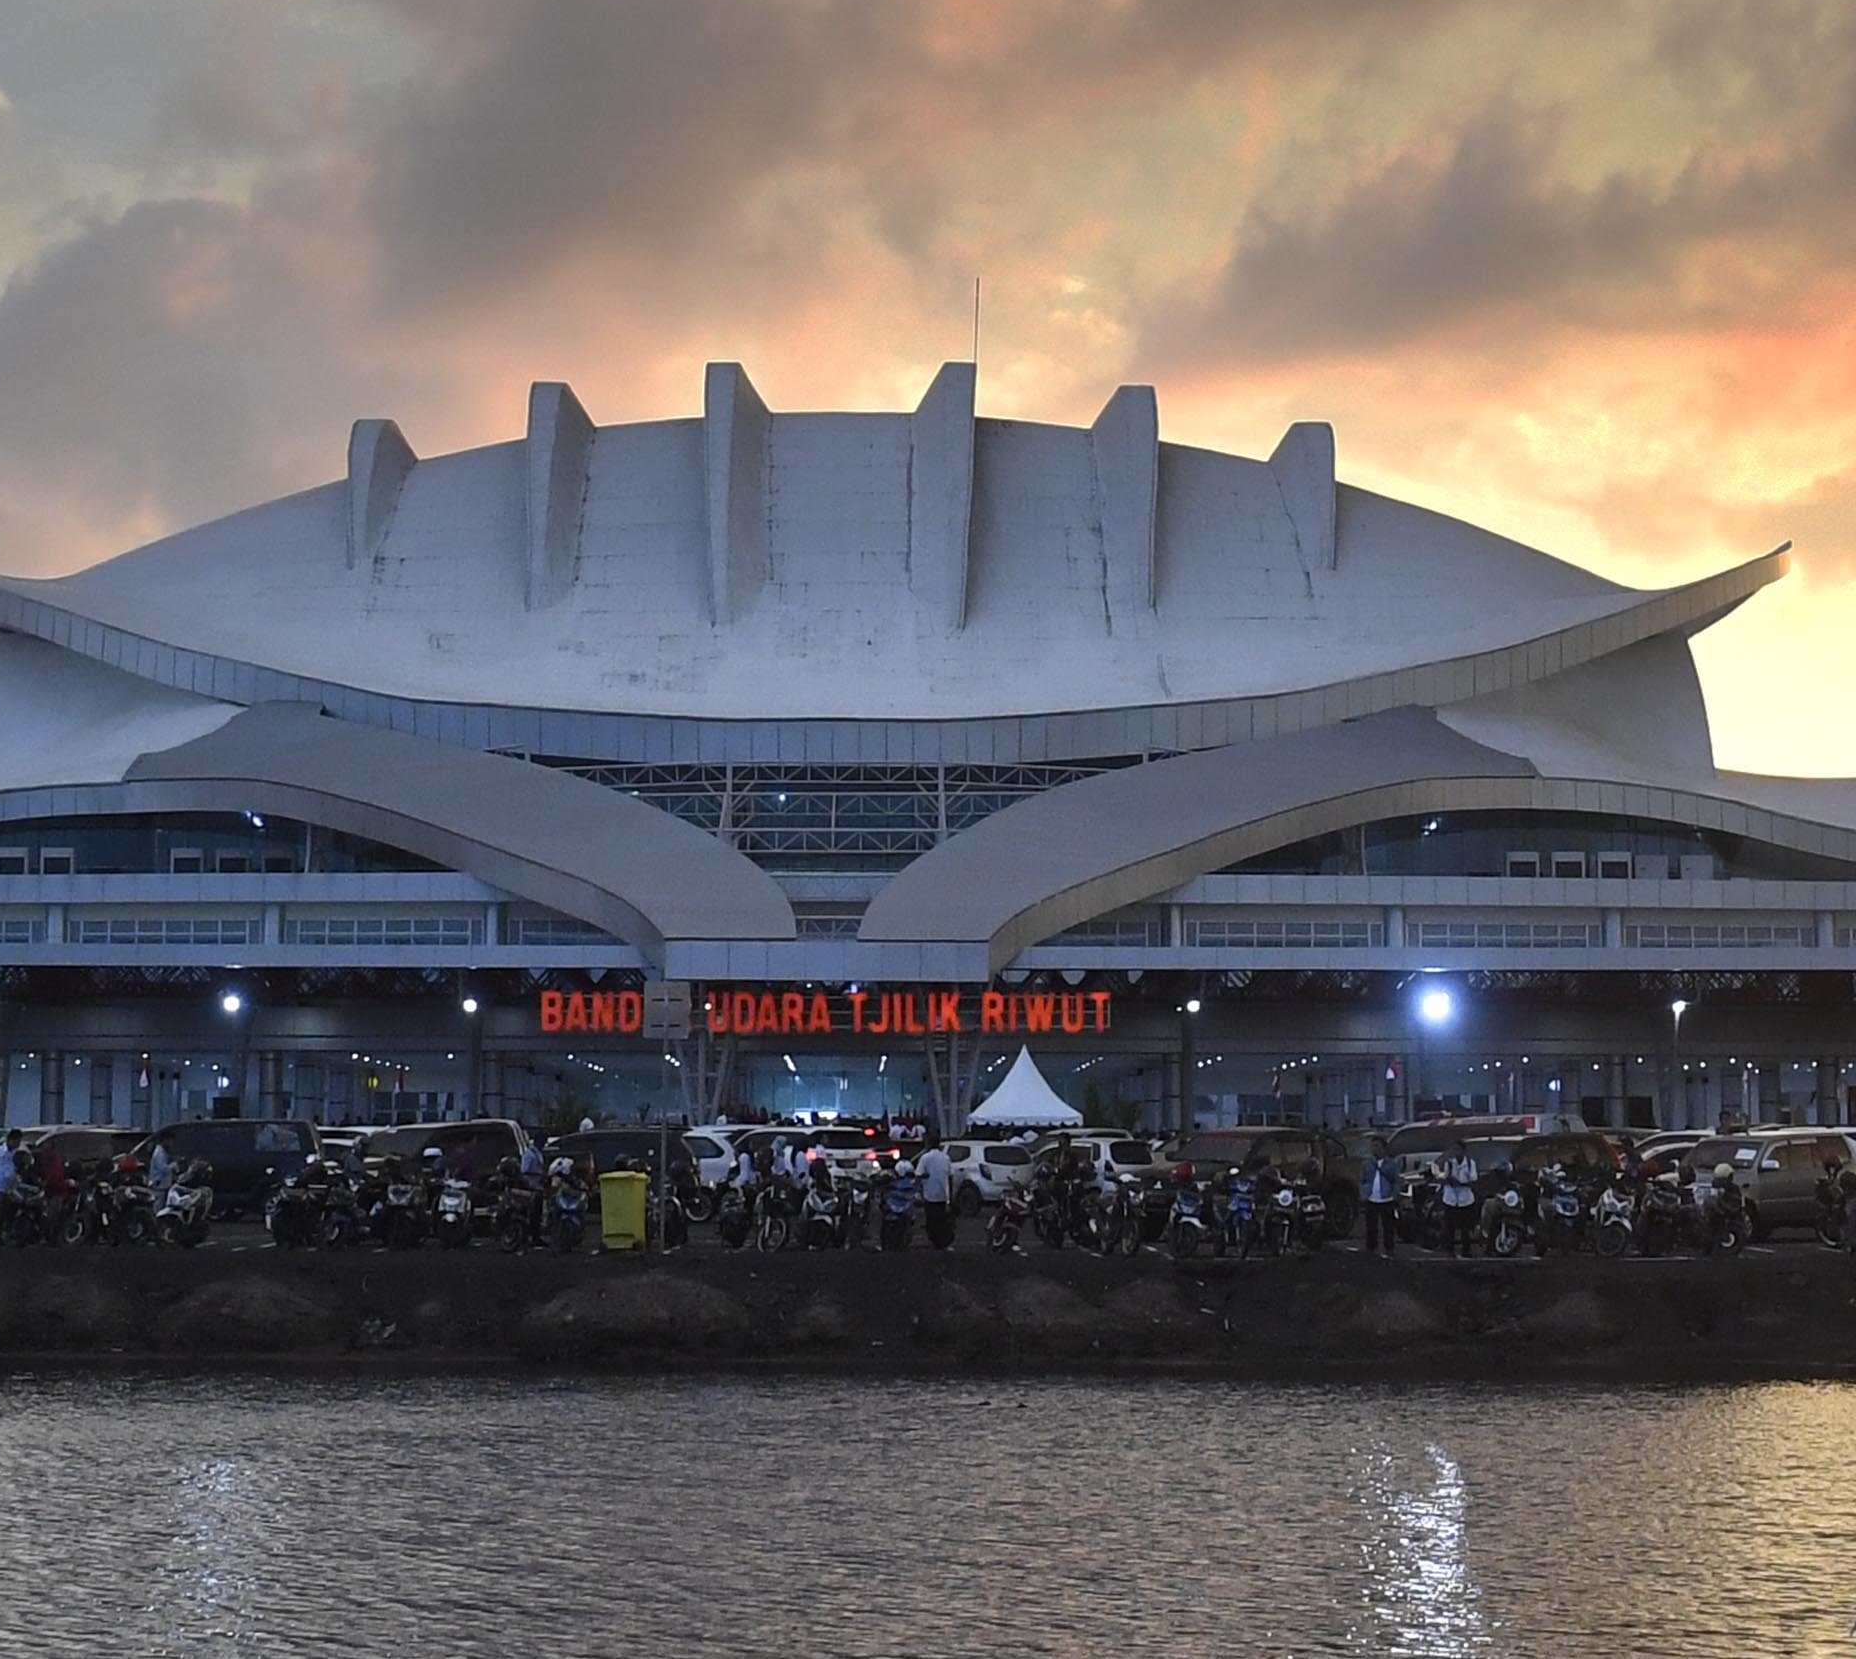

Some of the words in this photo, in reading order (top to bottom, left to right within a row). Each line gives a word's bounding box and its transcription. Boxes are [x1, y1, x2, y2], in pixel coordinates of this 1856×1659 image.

[541, 991, 691, 1032] BAND
[707, 991, 832, 1033] UDARA
[848, 992, 961, 1033] TJILIK
[981, 991, 1111, 1033] RIWUT
